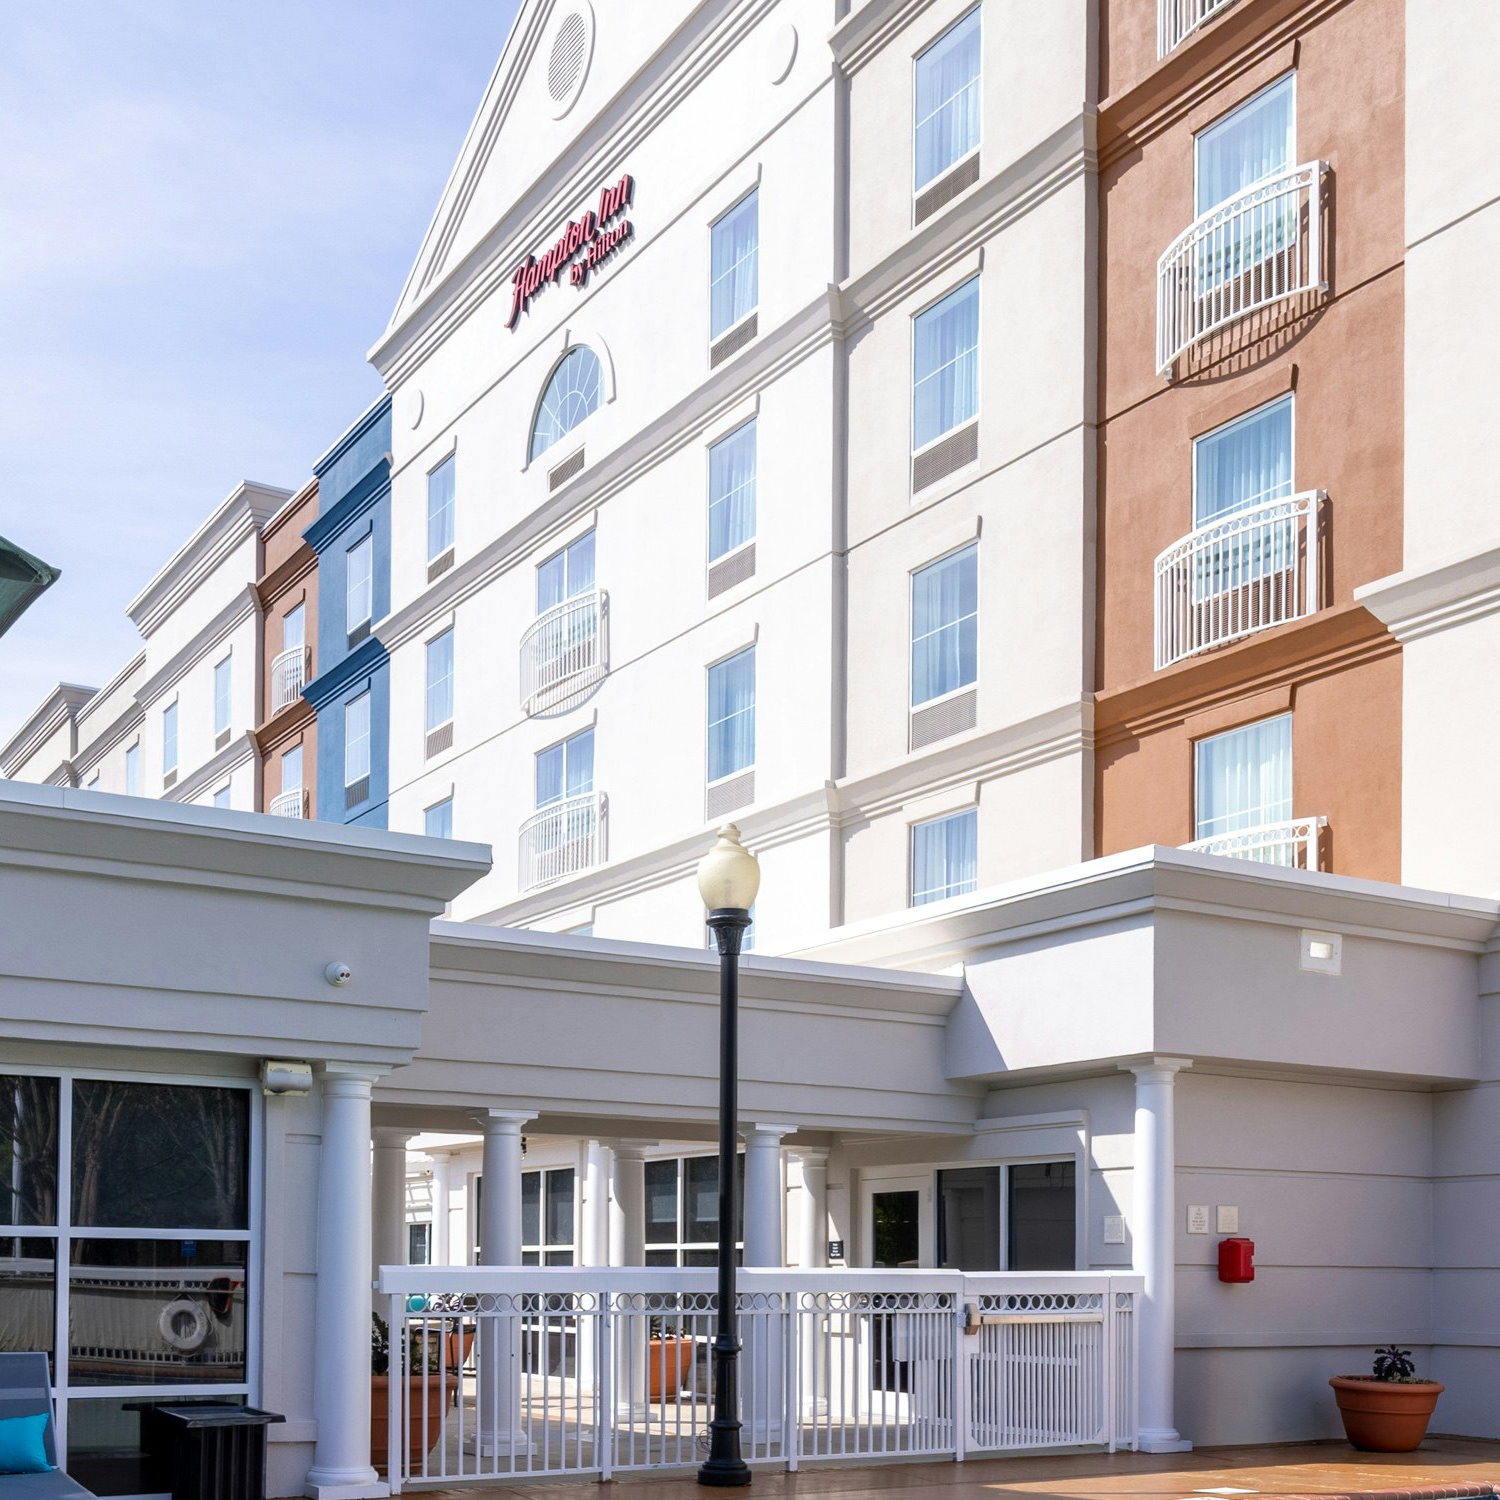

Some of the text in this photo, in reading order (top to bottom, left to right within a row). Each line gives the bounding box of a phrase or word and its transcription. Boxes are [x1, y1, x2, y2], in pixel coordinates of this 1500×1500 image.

[504, 174, 634, 329] Hampton Inn
[570, 219, 634, 286] by Hilton
